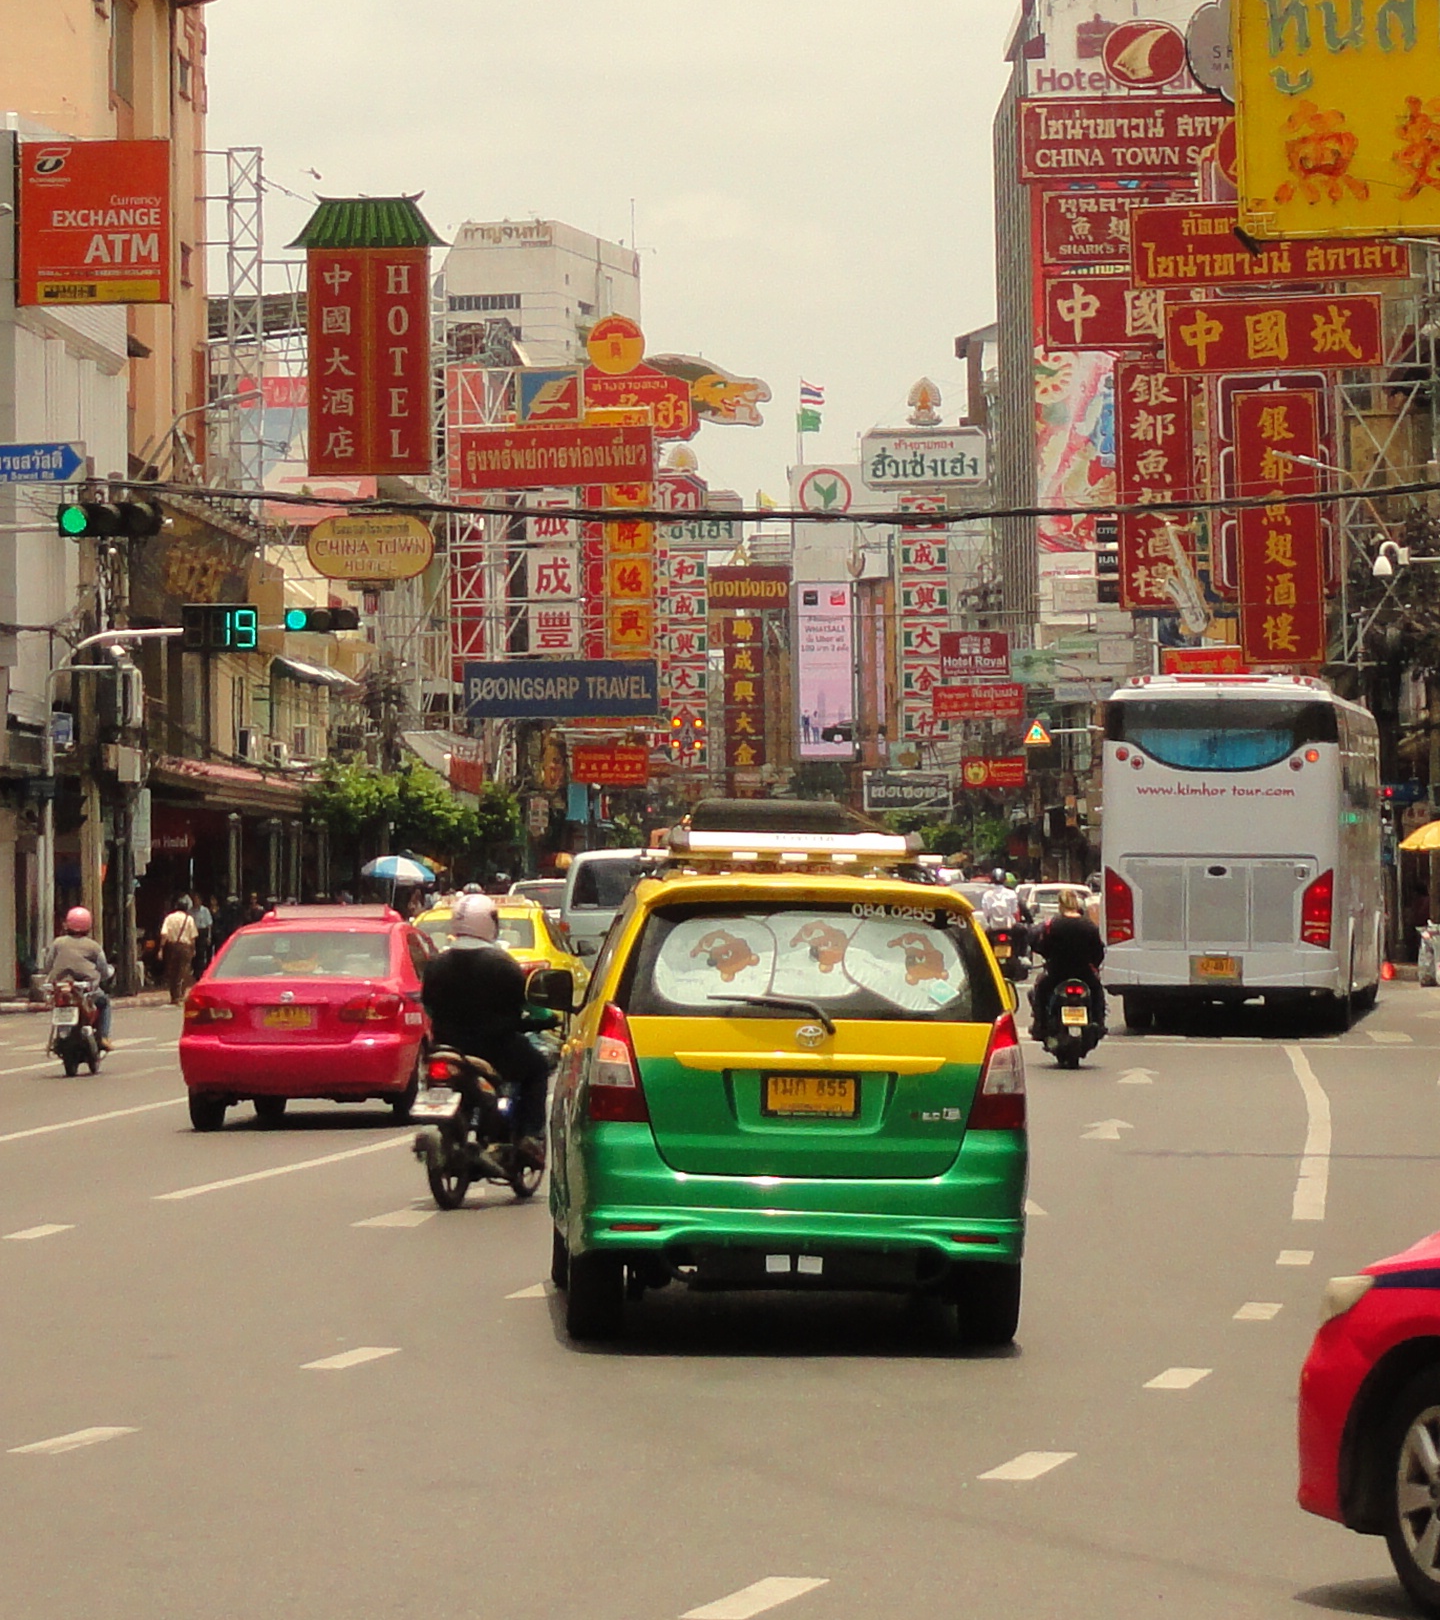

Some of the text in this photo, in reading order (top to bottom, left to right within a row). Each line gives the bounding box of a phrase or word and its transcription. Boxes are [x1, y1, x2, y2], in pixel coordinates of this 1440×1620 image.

[1035, 148, 1105, 168] CHINA
[1112, 146, 1180, 167] TOWN
[110, 194, 162, 207] Currency
[51, 208, 162, 228] EXCHANGE
[83, 233, 160, 264] ATM
[1057, 283, 1166, 343] 中國
[1180, 305, 1362, 367] 中國城
[321, 263, 356, 459] 中國大酒店
[385, 265, 411, 459] HOTEL
[315, 539, 370, 556] CHINA
[224, 609, 257, 649] 19
[943, 655, 1007, 668] Hotel Royal
[470, 676, 652, 702] ROONGSARP TRAVEL
[1136, 782, 1295, 797] www.kimhor tour.com
[851, 903, 886, 918] 084
[890, 905, 936, 923] 0255
